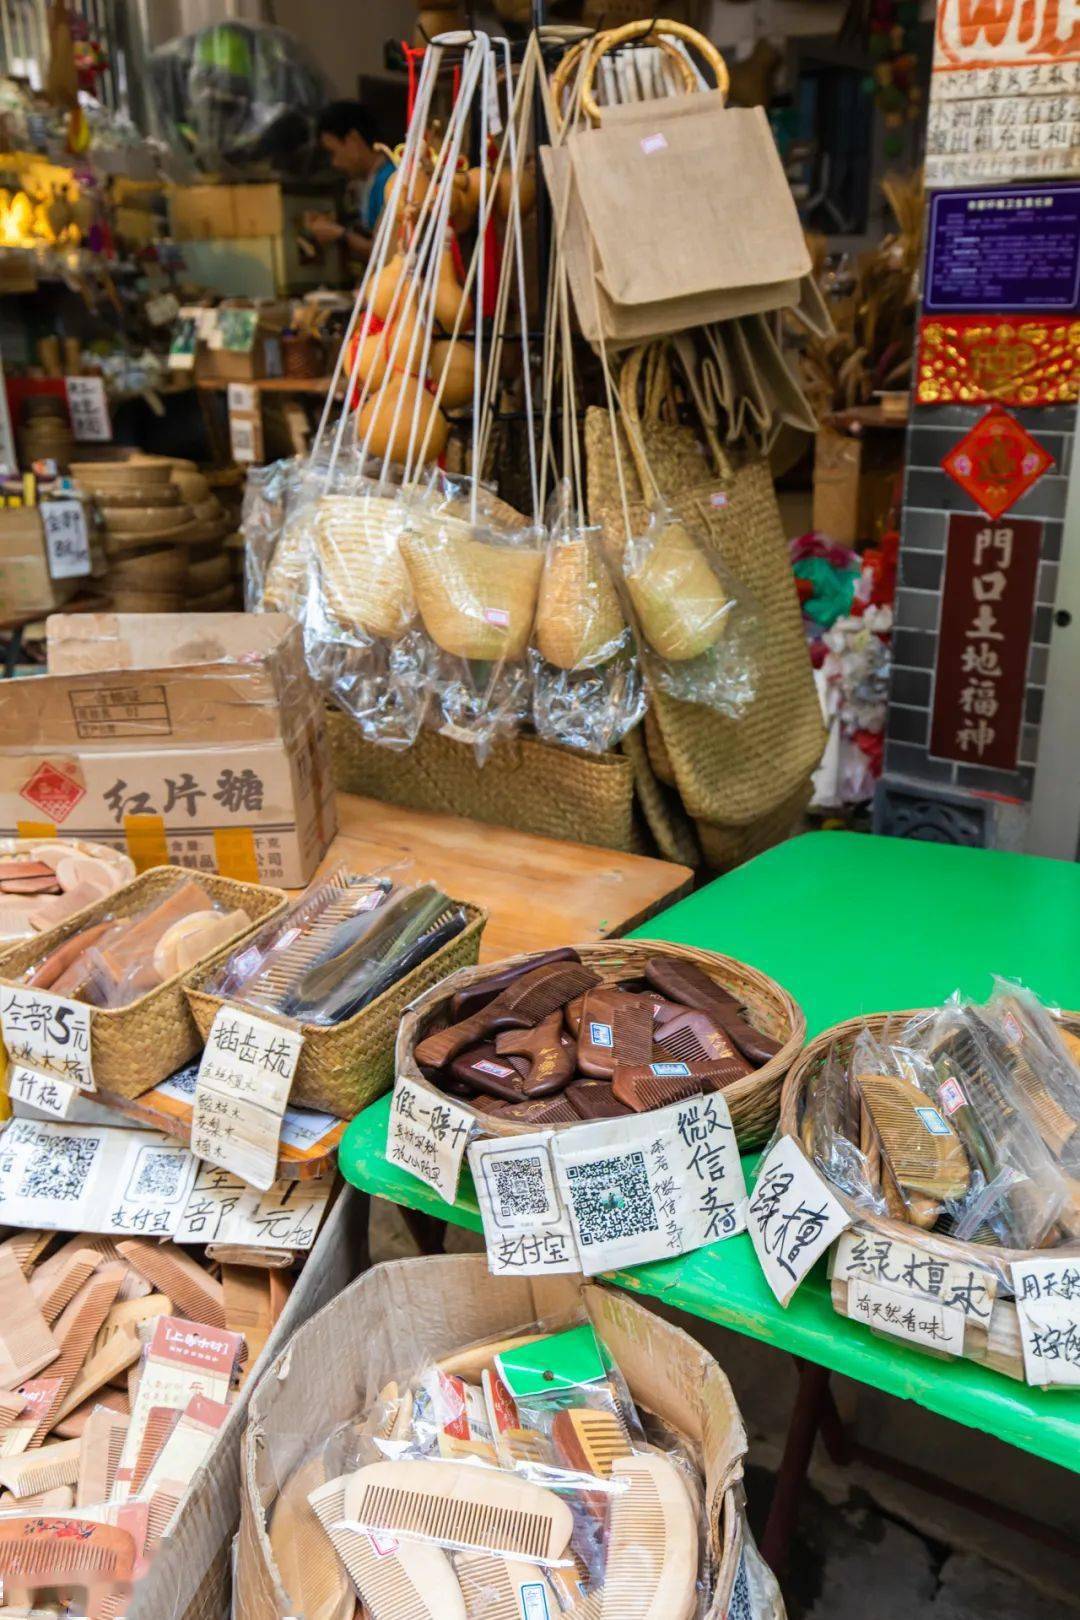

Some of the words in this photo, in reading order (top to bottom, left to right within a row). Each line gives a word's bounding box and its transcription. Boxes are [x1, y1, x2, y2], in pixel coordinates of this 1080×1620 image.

[956, 527, 1014, 757] 門口土地福神
[103, 768, 265, 823] 红片糖
[3, 994, 90, 1052] 全部5元
[214, 1020, 292, 1079] 插齿梳
[17, 1072, 63, 1111] 竹梳
[396, 1085, 468, 1150] 假一赔十
[677, 1098, 733, 1239] 微信支付
[110, 1204, 172, 1235] 支付宝
[749, 1163, 831, 1282] 绿檀
[498, 1231, 570, 1270] 支付宝
[846, 1239, 991, 1318] 绿檀木
[855, 1294, 953, 1343] 有天然香味
